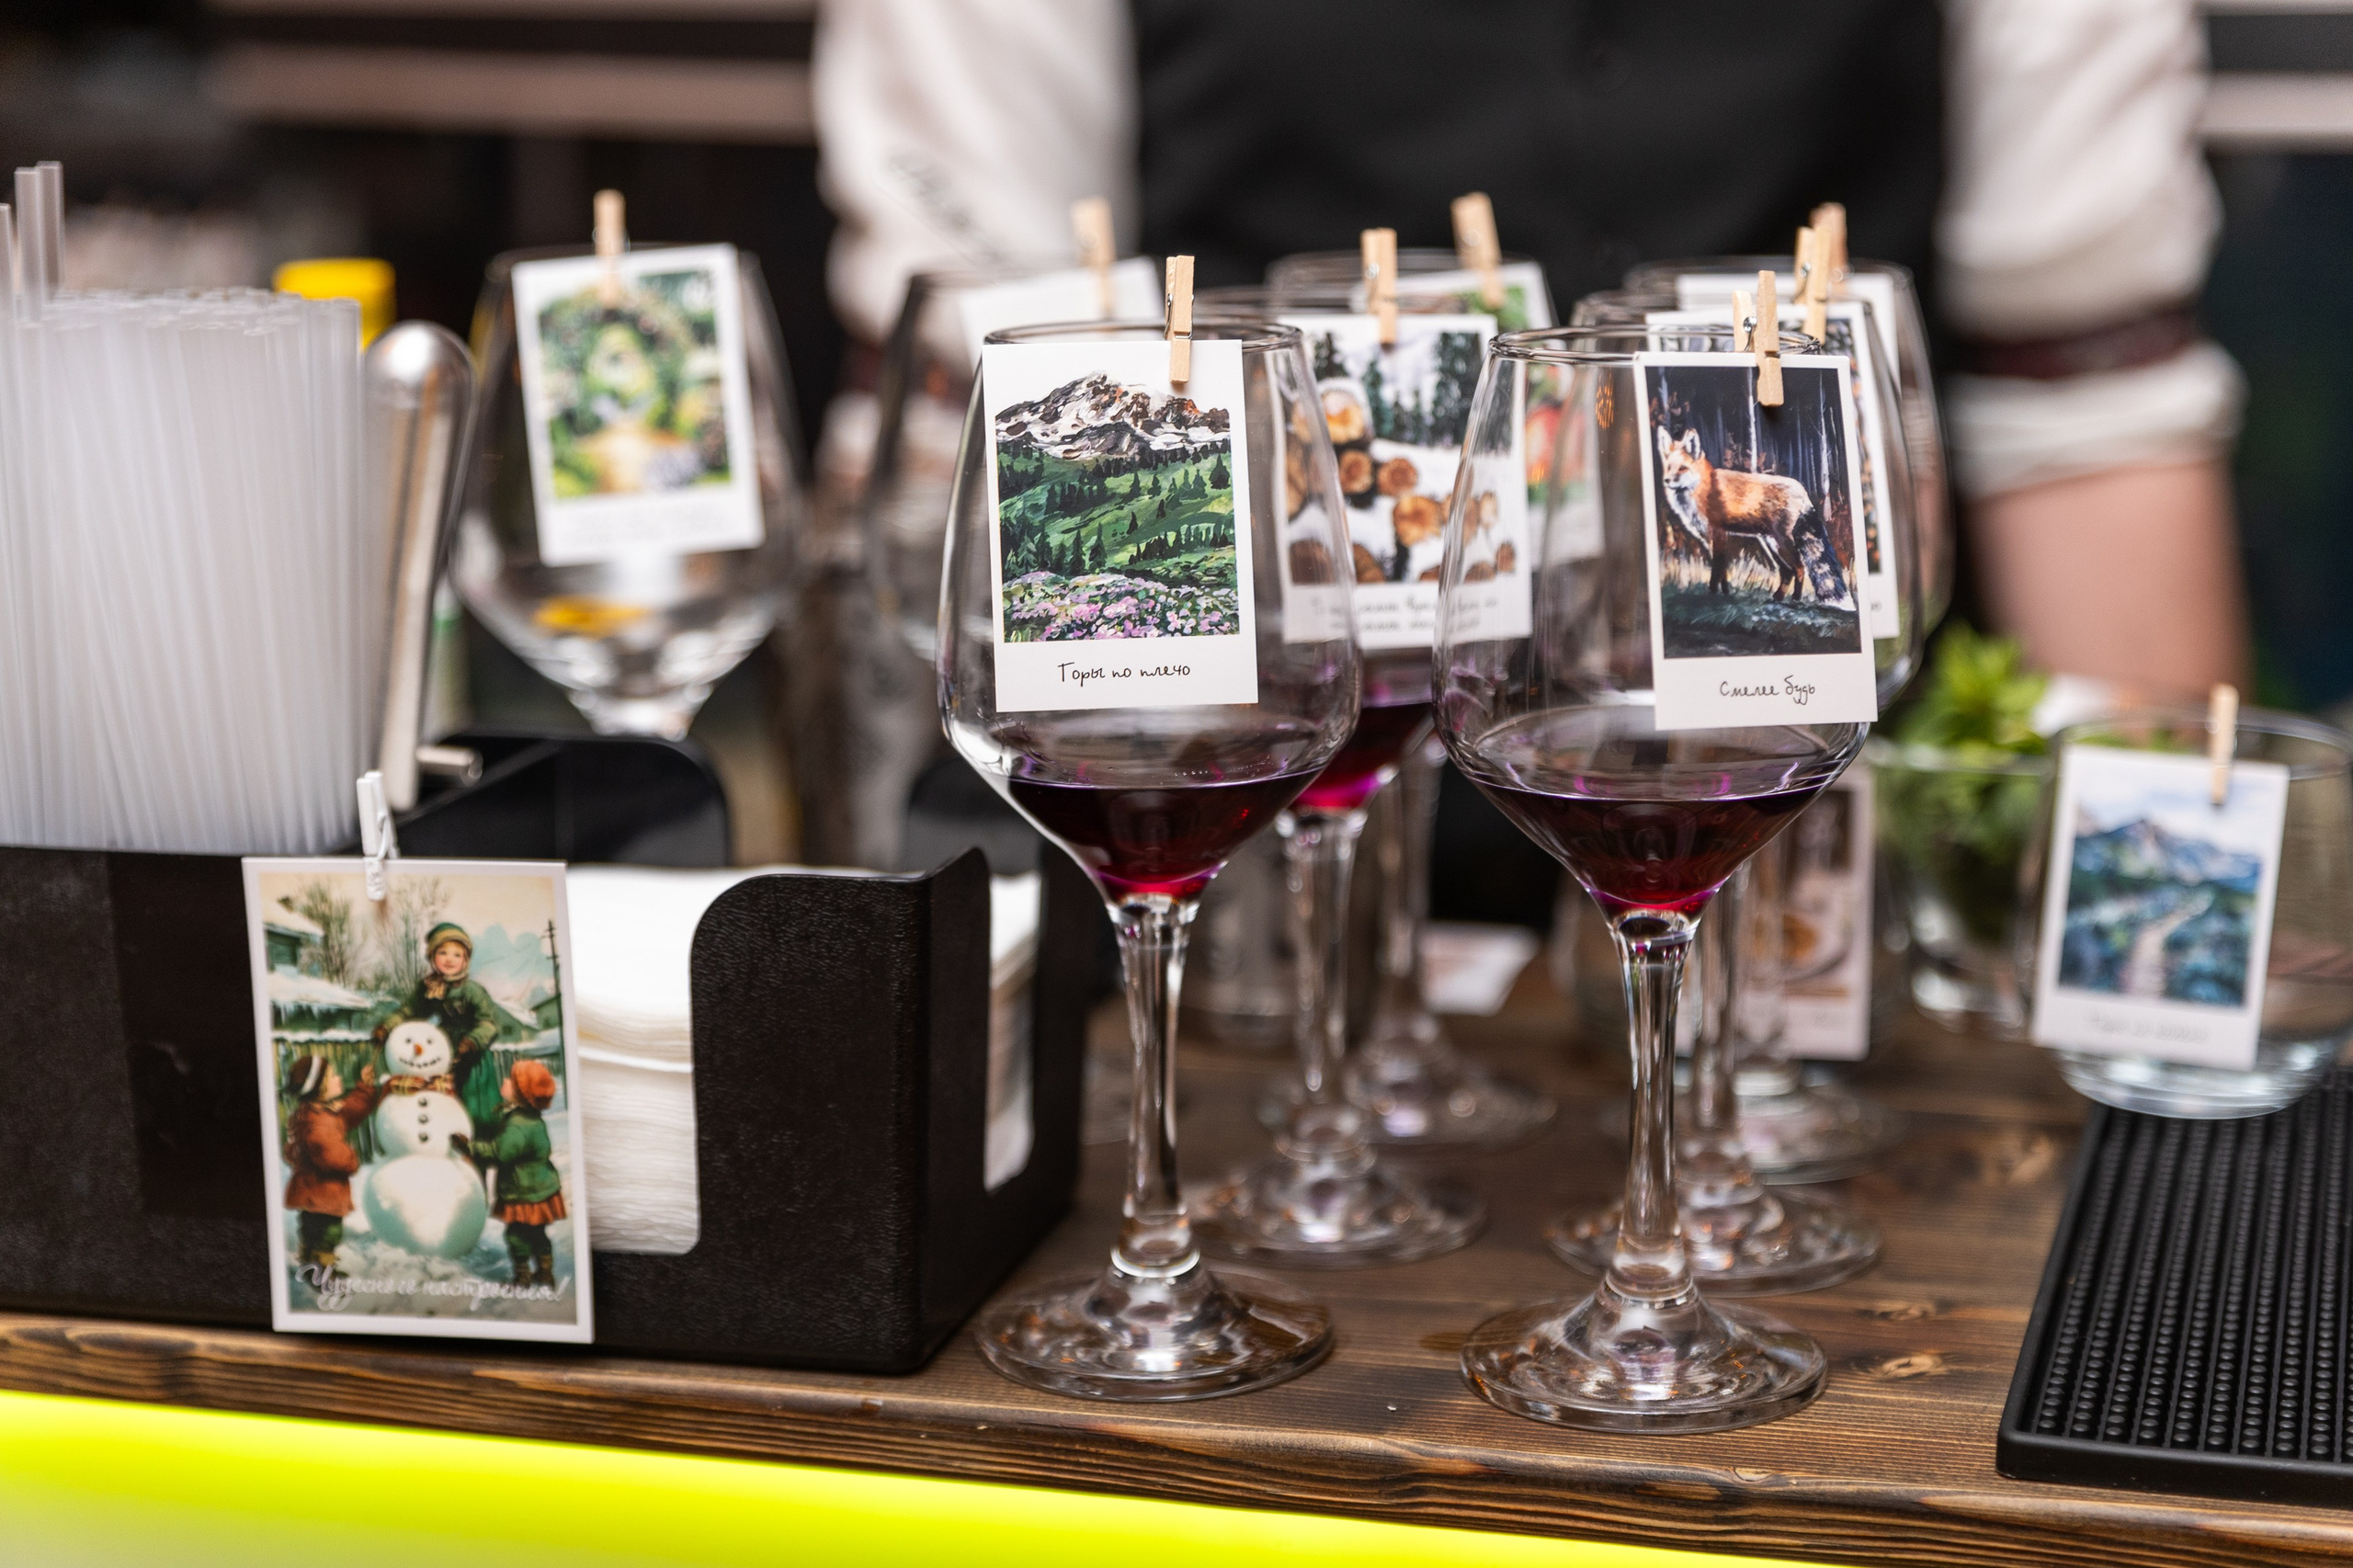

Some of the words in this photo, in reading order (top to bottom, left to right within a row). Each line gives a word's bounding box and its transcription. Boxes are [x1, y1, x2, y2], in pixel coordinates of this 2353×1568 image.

[1057, 662, 1105, 687] Горы
[1111, 667, 1131, 678] по
[1140, 665, 1191, 677] плечо
[1720, 680, 1779, 698] Смелее
[1784, 675, 1816, 706] будь
